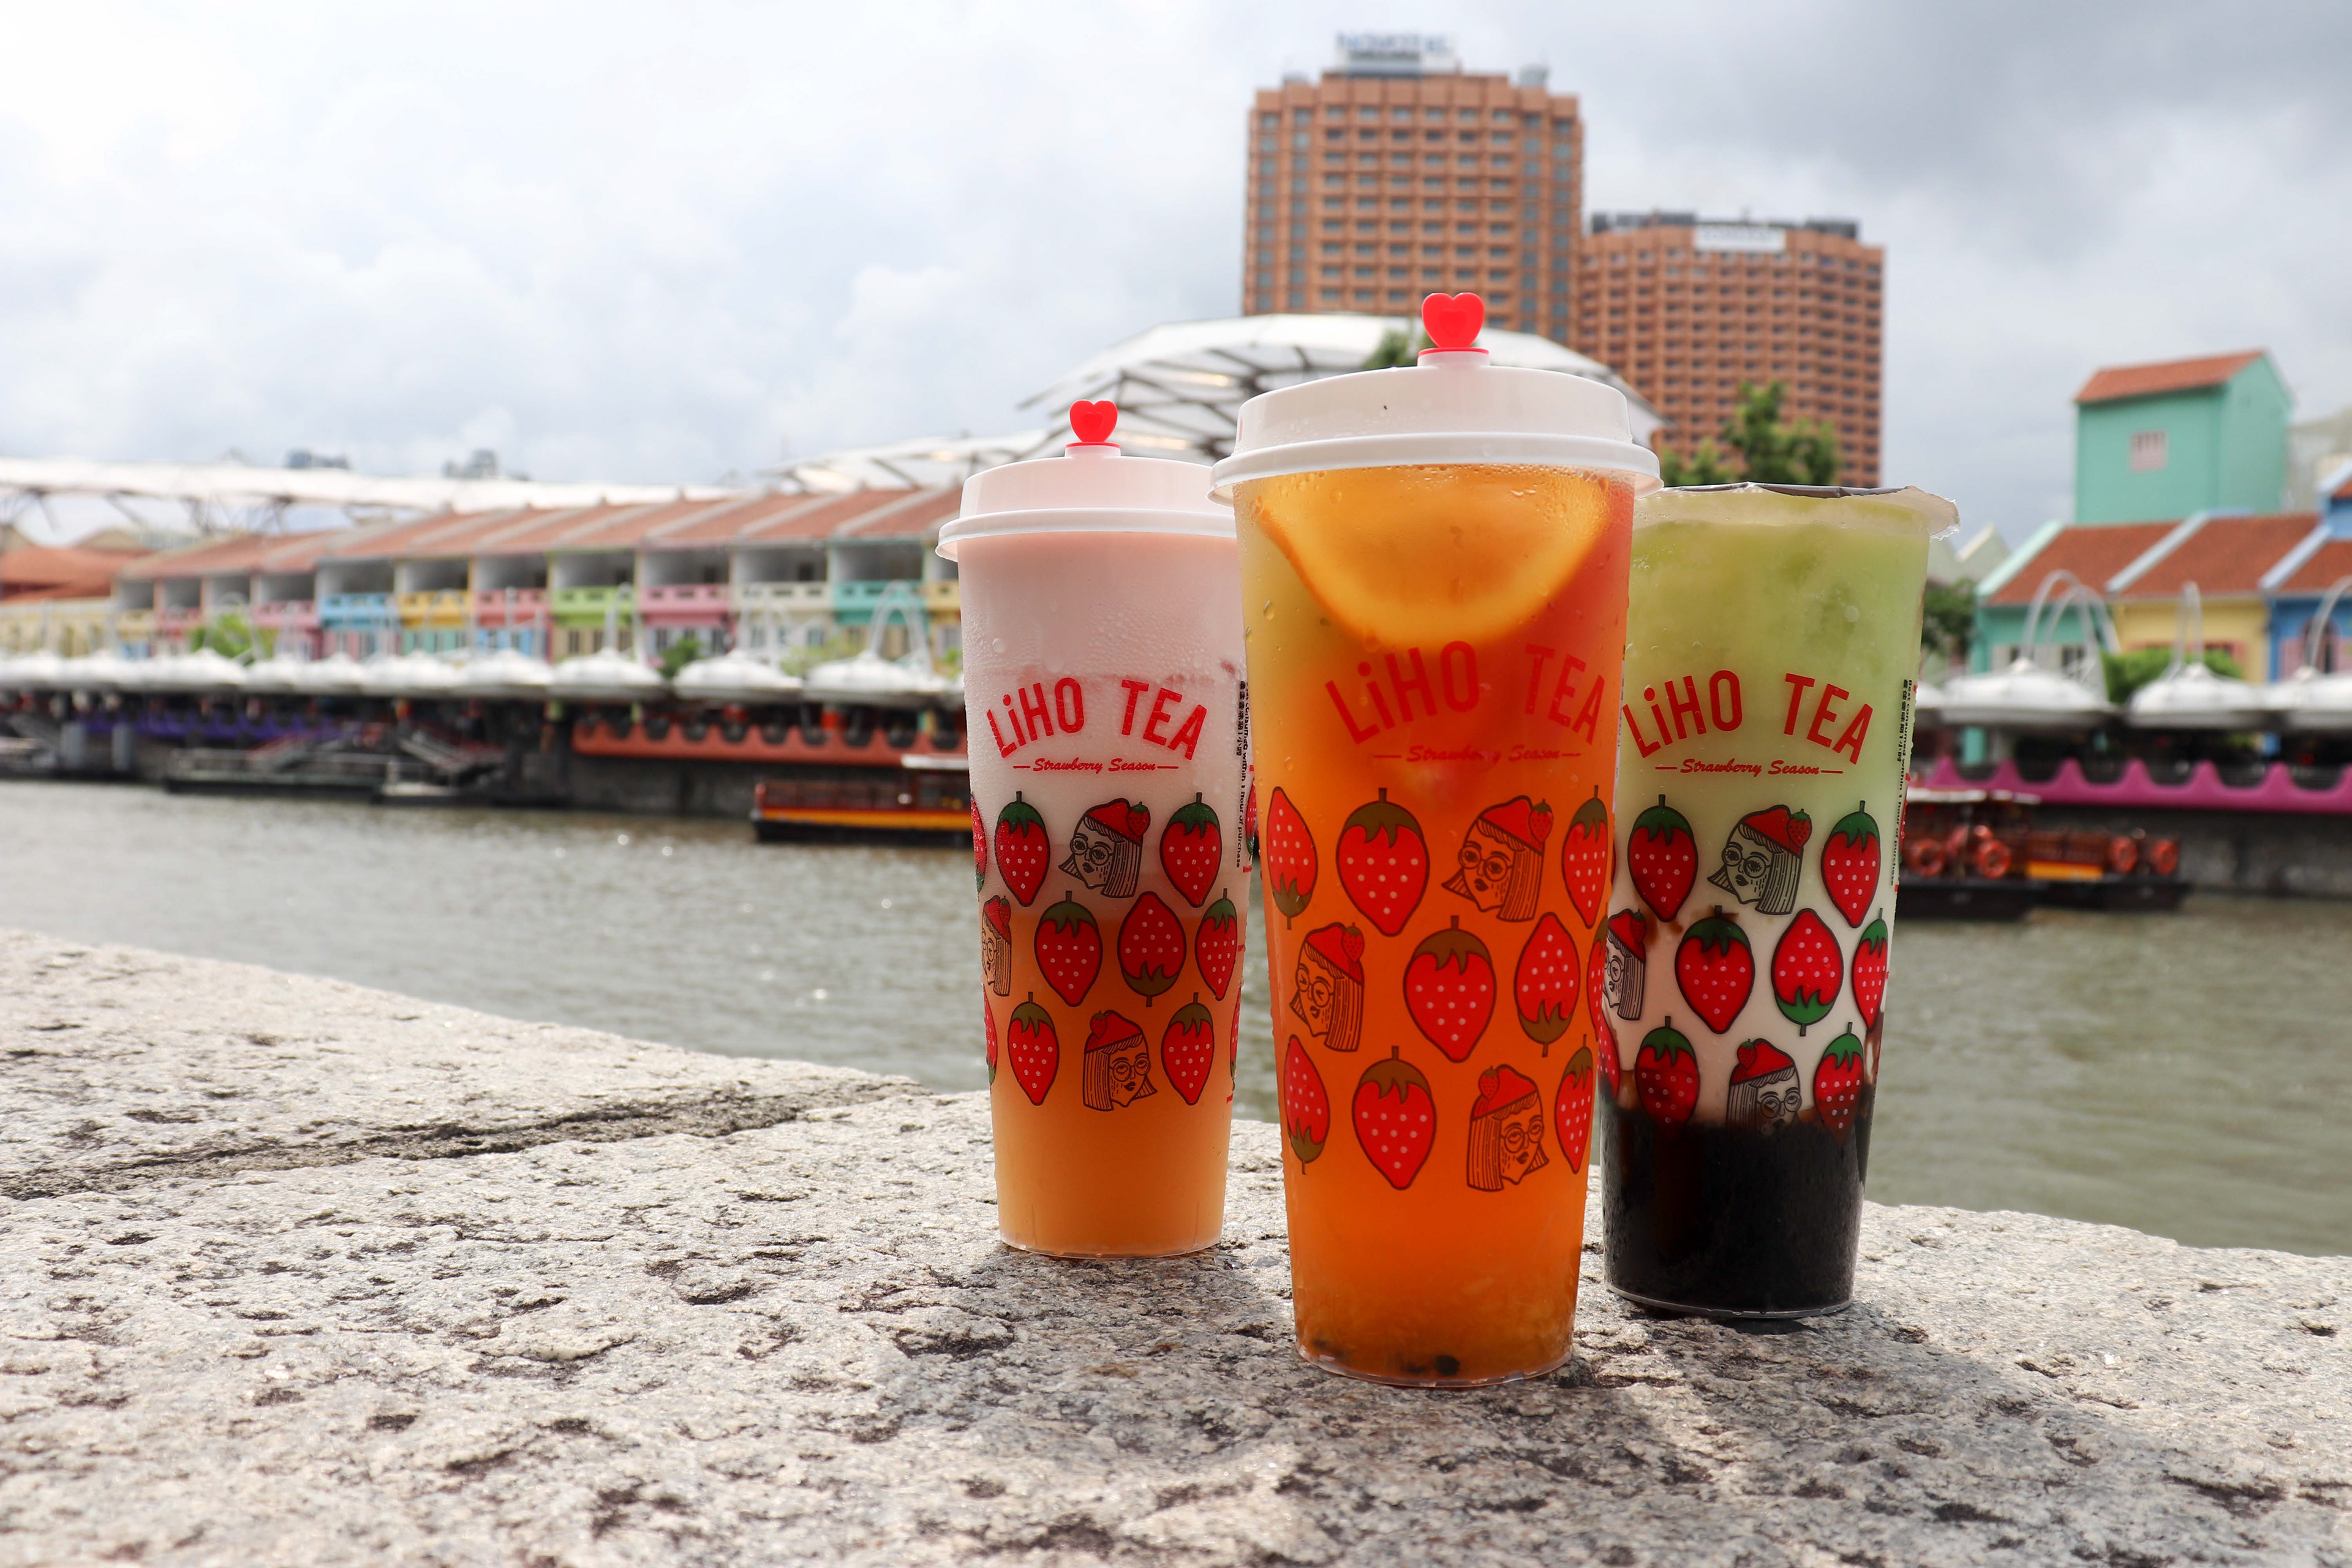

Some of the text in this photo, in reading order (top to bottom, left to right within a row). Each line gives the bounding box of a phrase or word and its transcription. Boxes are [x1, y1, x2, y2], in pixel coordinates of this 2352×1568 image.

[986, 677, 1207, 761] LiHO TEA
[1325, 641, 1480, 745] LiHO
[1524, 642, 1605, 745] TEA
[1622, 670, 1743, 758] LiHO
[1783, 673, 1874, 765] TEA
[1032, 756, 1156, 775] Strawberry Season
[1507, 743, 1560, 763] Season
[1680, 758, 1820, 777] Strawberry Season
